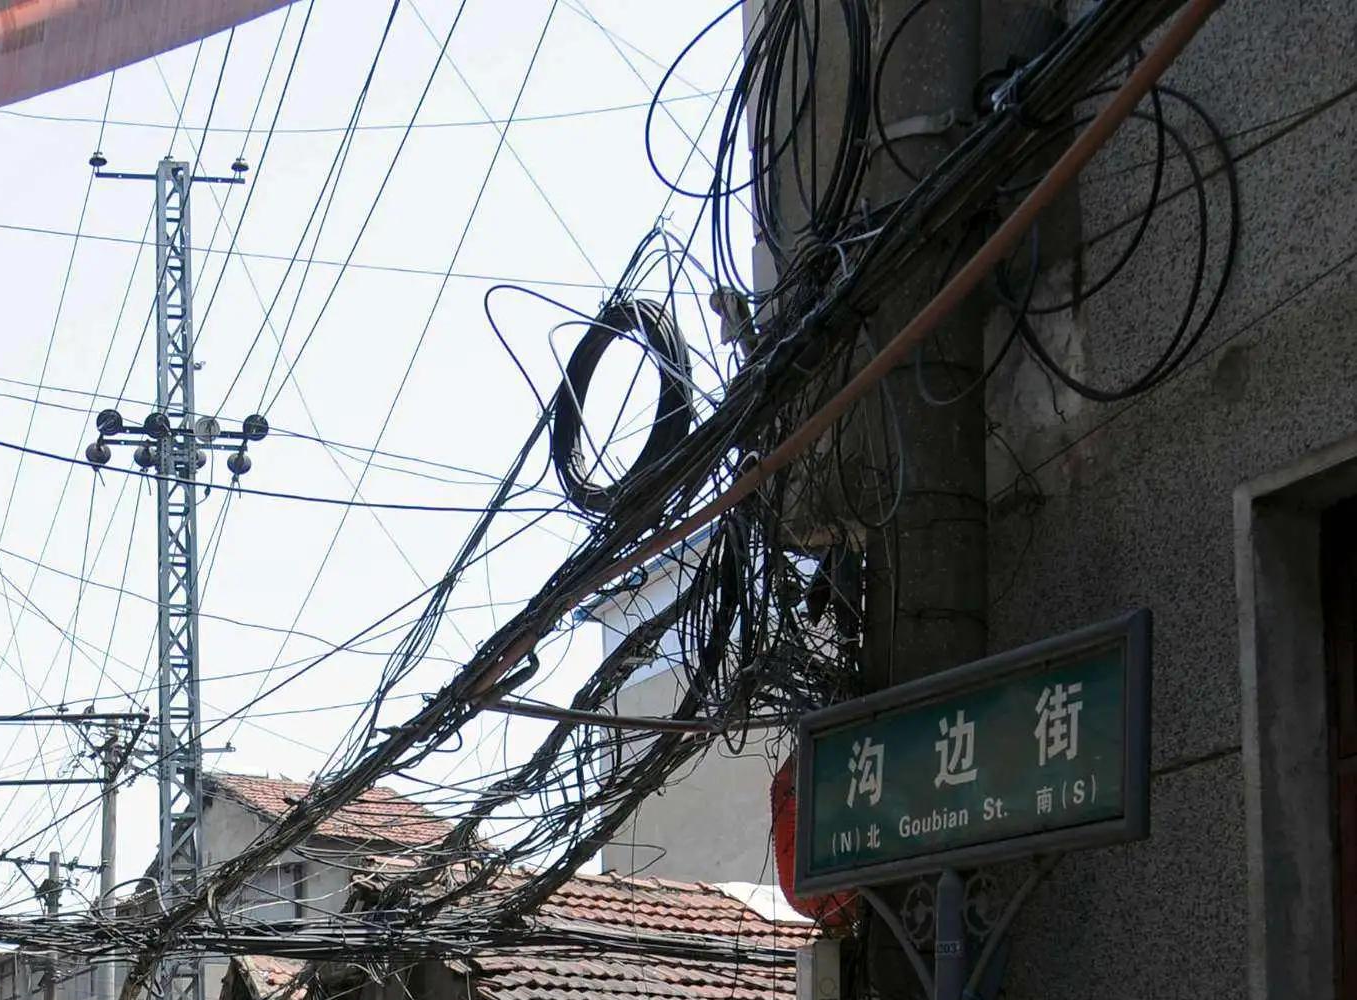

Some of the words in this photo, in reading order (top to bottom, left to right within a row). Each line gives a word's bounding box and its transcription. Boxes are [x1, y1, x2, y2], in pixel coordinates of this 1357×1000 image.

[846, 681, 1084, 809] 沟边街
[898, 807, 969, 838] Goubian
[982, 797, 1009, 822] St.
